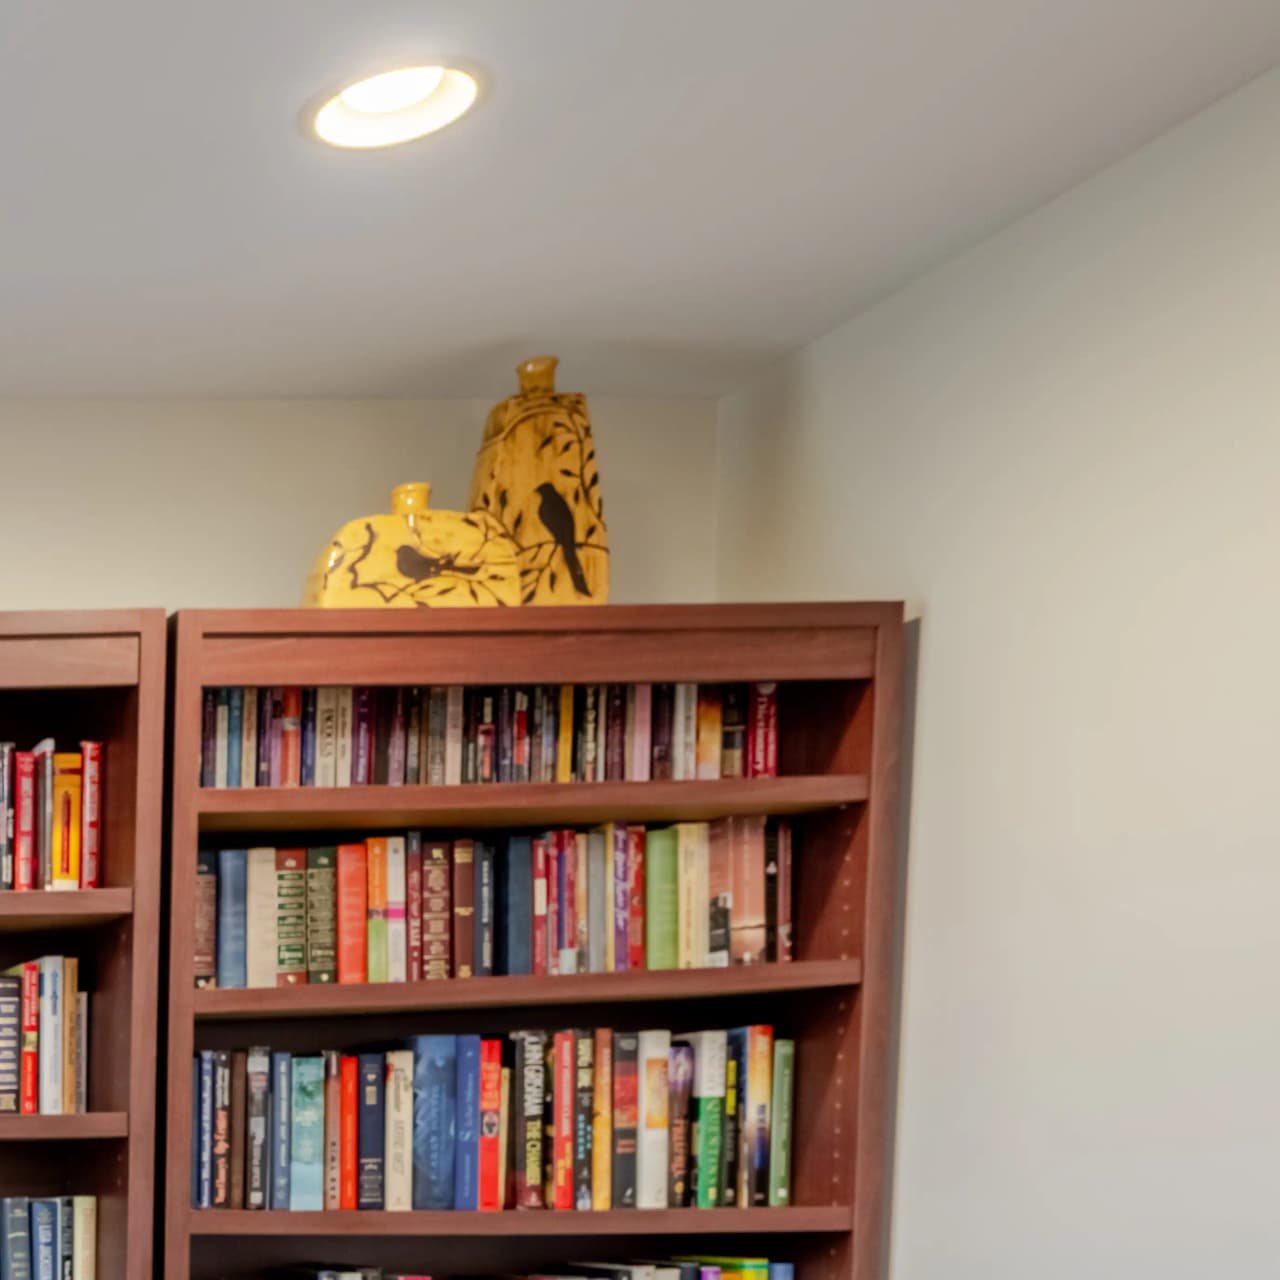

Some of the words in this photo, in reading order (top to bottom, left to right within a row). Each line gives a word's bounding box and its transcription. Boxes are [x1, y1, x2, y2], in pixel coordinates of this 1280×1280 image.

[525, 1036, 544, 1064] JOHN
[525, 1066, 544, 1117] GRISHAM
[526, 1120, 541, 1138] THE
[526, 1140, 541, 1187] CHAMBER
